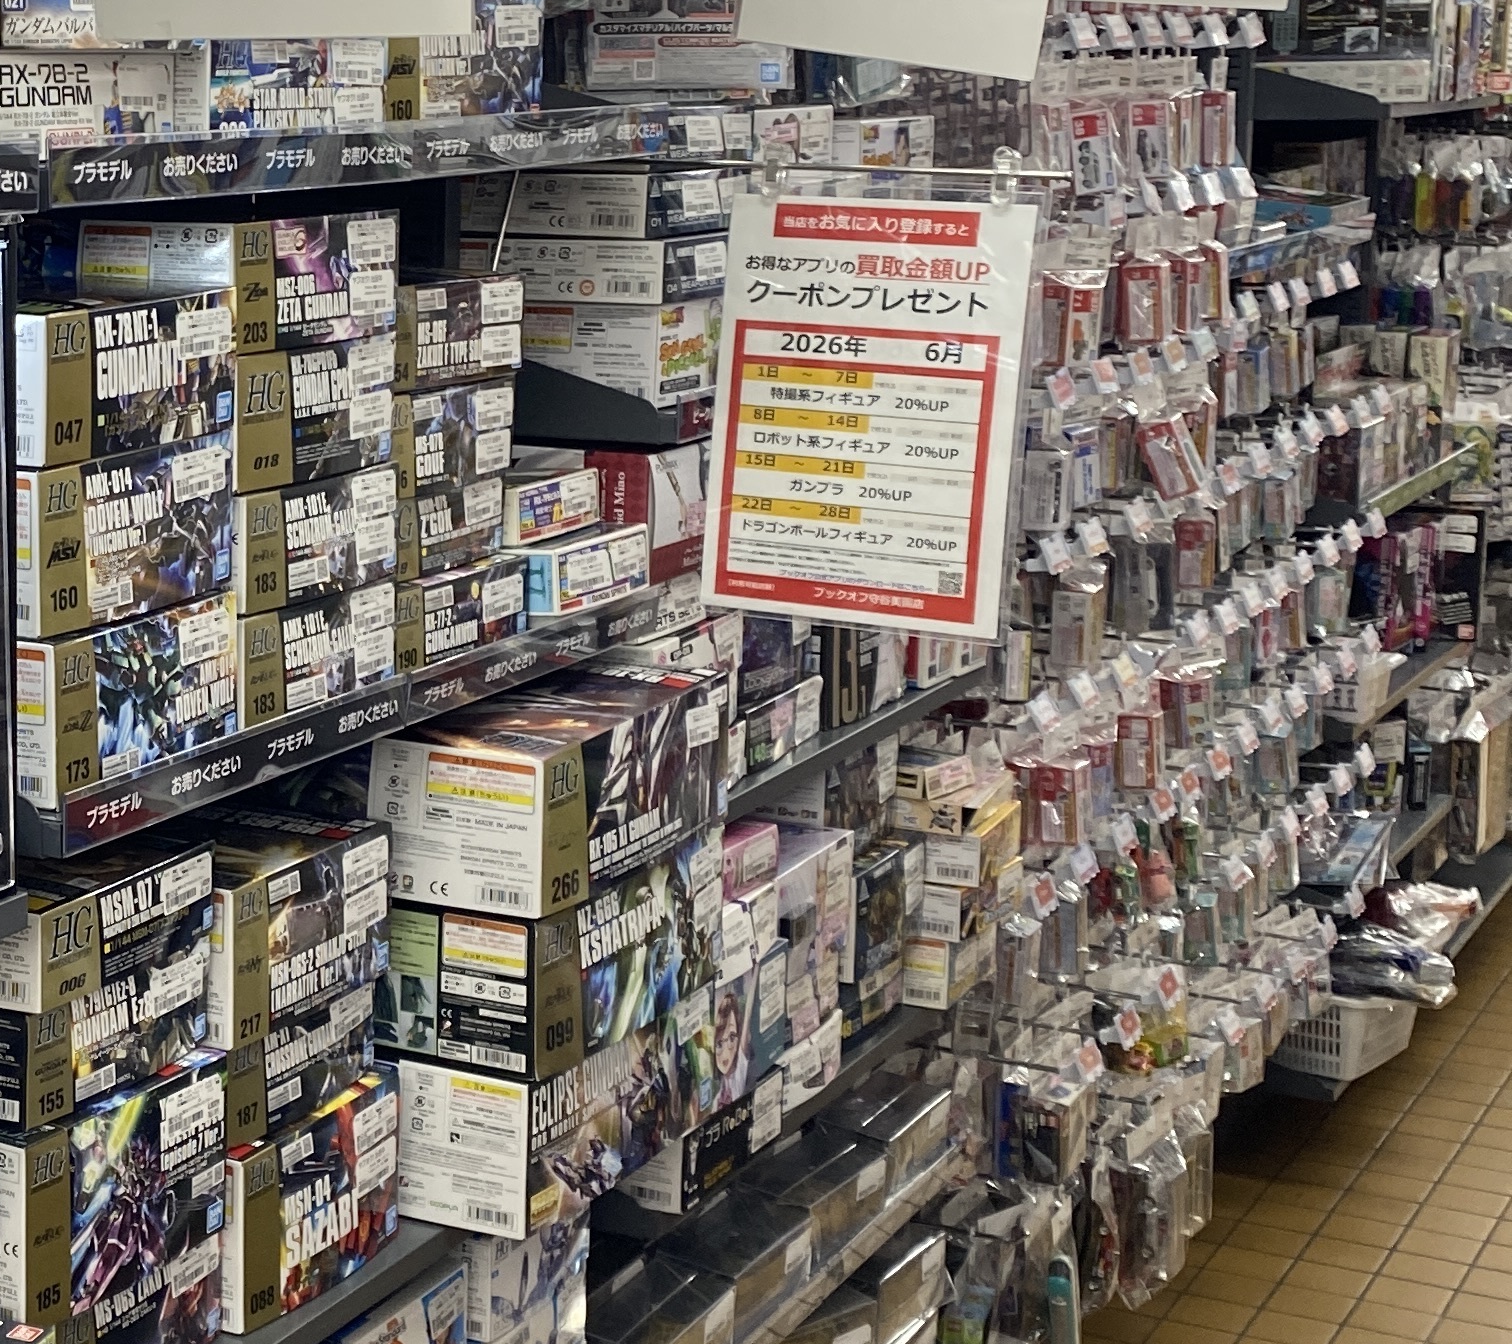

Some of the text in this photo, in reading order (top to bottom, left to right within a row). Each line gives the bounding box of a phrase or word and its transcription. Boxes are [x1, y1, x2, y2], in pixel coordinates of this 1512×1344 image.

[0, 64, 88, 85] RX-78-2
[0, 86, 92, 107] GUNDAM
[73, 152, 238, 184] プラモデル お売りください
[783, 215, 969, 237] 当店をお気に入り登録すると
[745, 253, 990, 281] お得なアプリの買取金額UP
[748, 279, 988, 317] クーポンプレゼント
[243, 322, 268, 344] 203
[781, 332, 963, 365] 2026年 6月
[758, 366, 858, 384] 1日 7日
[895, 397, 949, 412] 20%UP
[754, 409, 858, 428] 8日 14日
[54, 420, 83, 446] 047
[754, 432, 959, 459] ロボット系フィギュア 20%UP
[823, 461, 854, 474] 21日
[790, 479, 912, 502] ガンプラ 20%UP
[742, 499, 850, 519] 22日 28日
[741, 519, 957, 551] ドラゴンボールフィギュア 20%UP
[50, 587, 78, 612] 160
[87, 756, 242, 827] プラモデル お売りください
[551, 876, 580, 902] 266
[286, 1176, 333, 1217] MSN-04
[286, 1192, 359, 1269] SAZABI
[36, 1285, 61, 1308] 185
